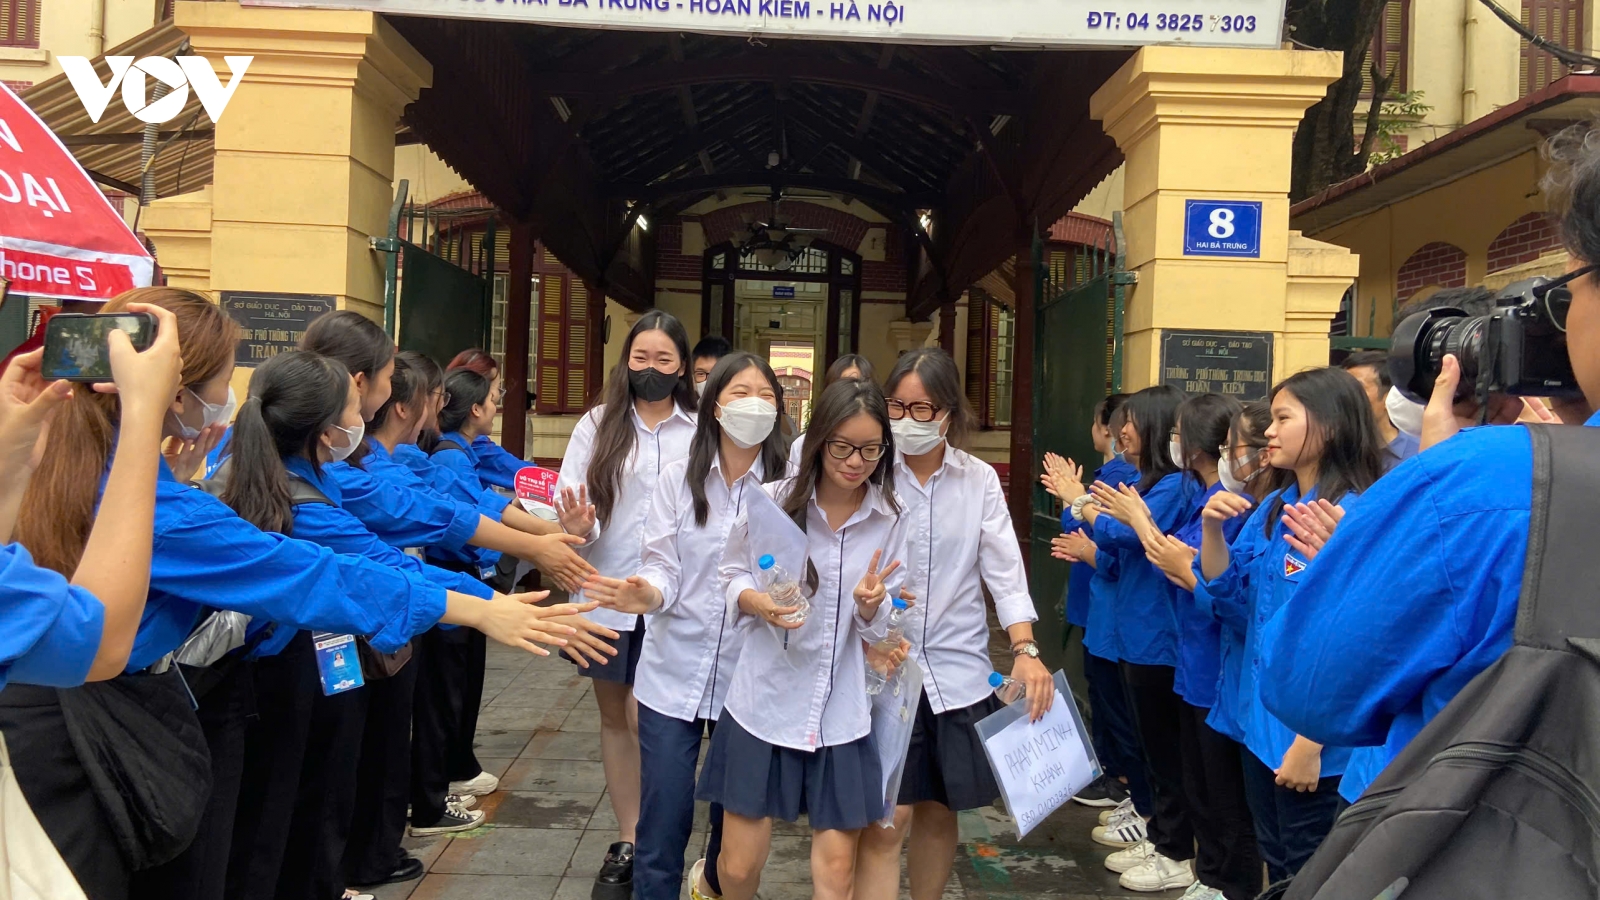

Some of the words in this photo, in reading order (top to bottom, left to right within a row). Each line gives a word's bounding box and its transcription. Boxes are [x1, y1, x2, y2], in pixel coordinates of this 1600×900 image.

[830, 0, 861, 21] HÀ
[867, 1, 904, 27] NỘI
[1087, 11, 1121, 30] ĐT:
[1126, 12, 1149, 30] 04
[1156, 13, 1204, 31] 3825
[1209, 14, 1257, 33] 7303
[1207, 207, 1235, 239] 8
[1222, 242, 1247, 250] TRƯNG
[1034, 721, 1074, 757] MINH
